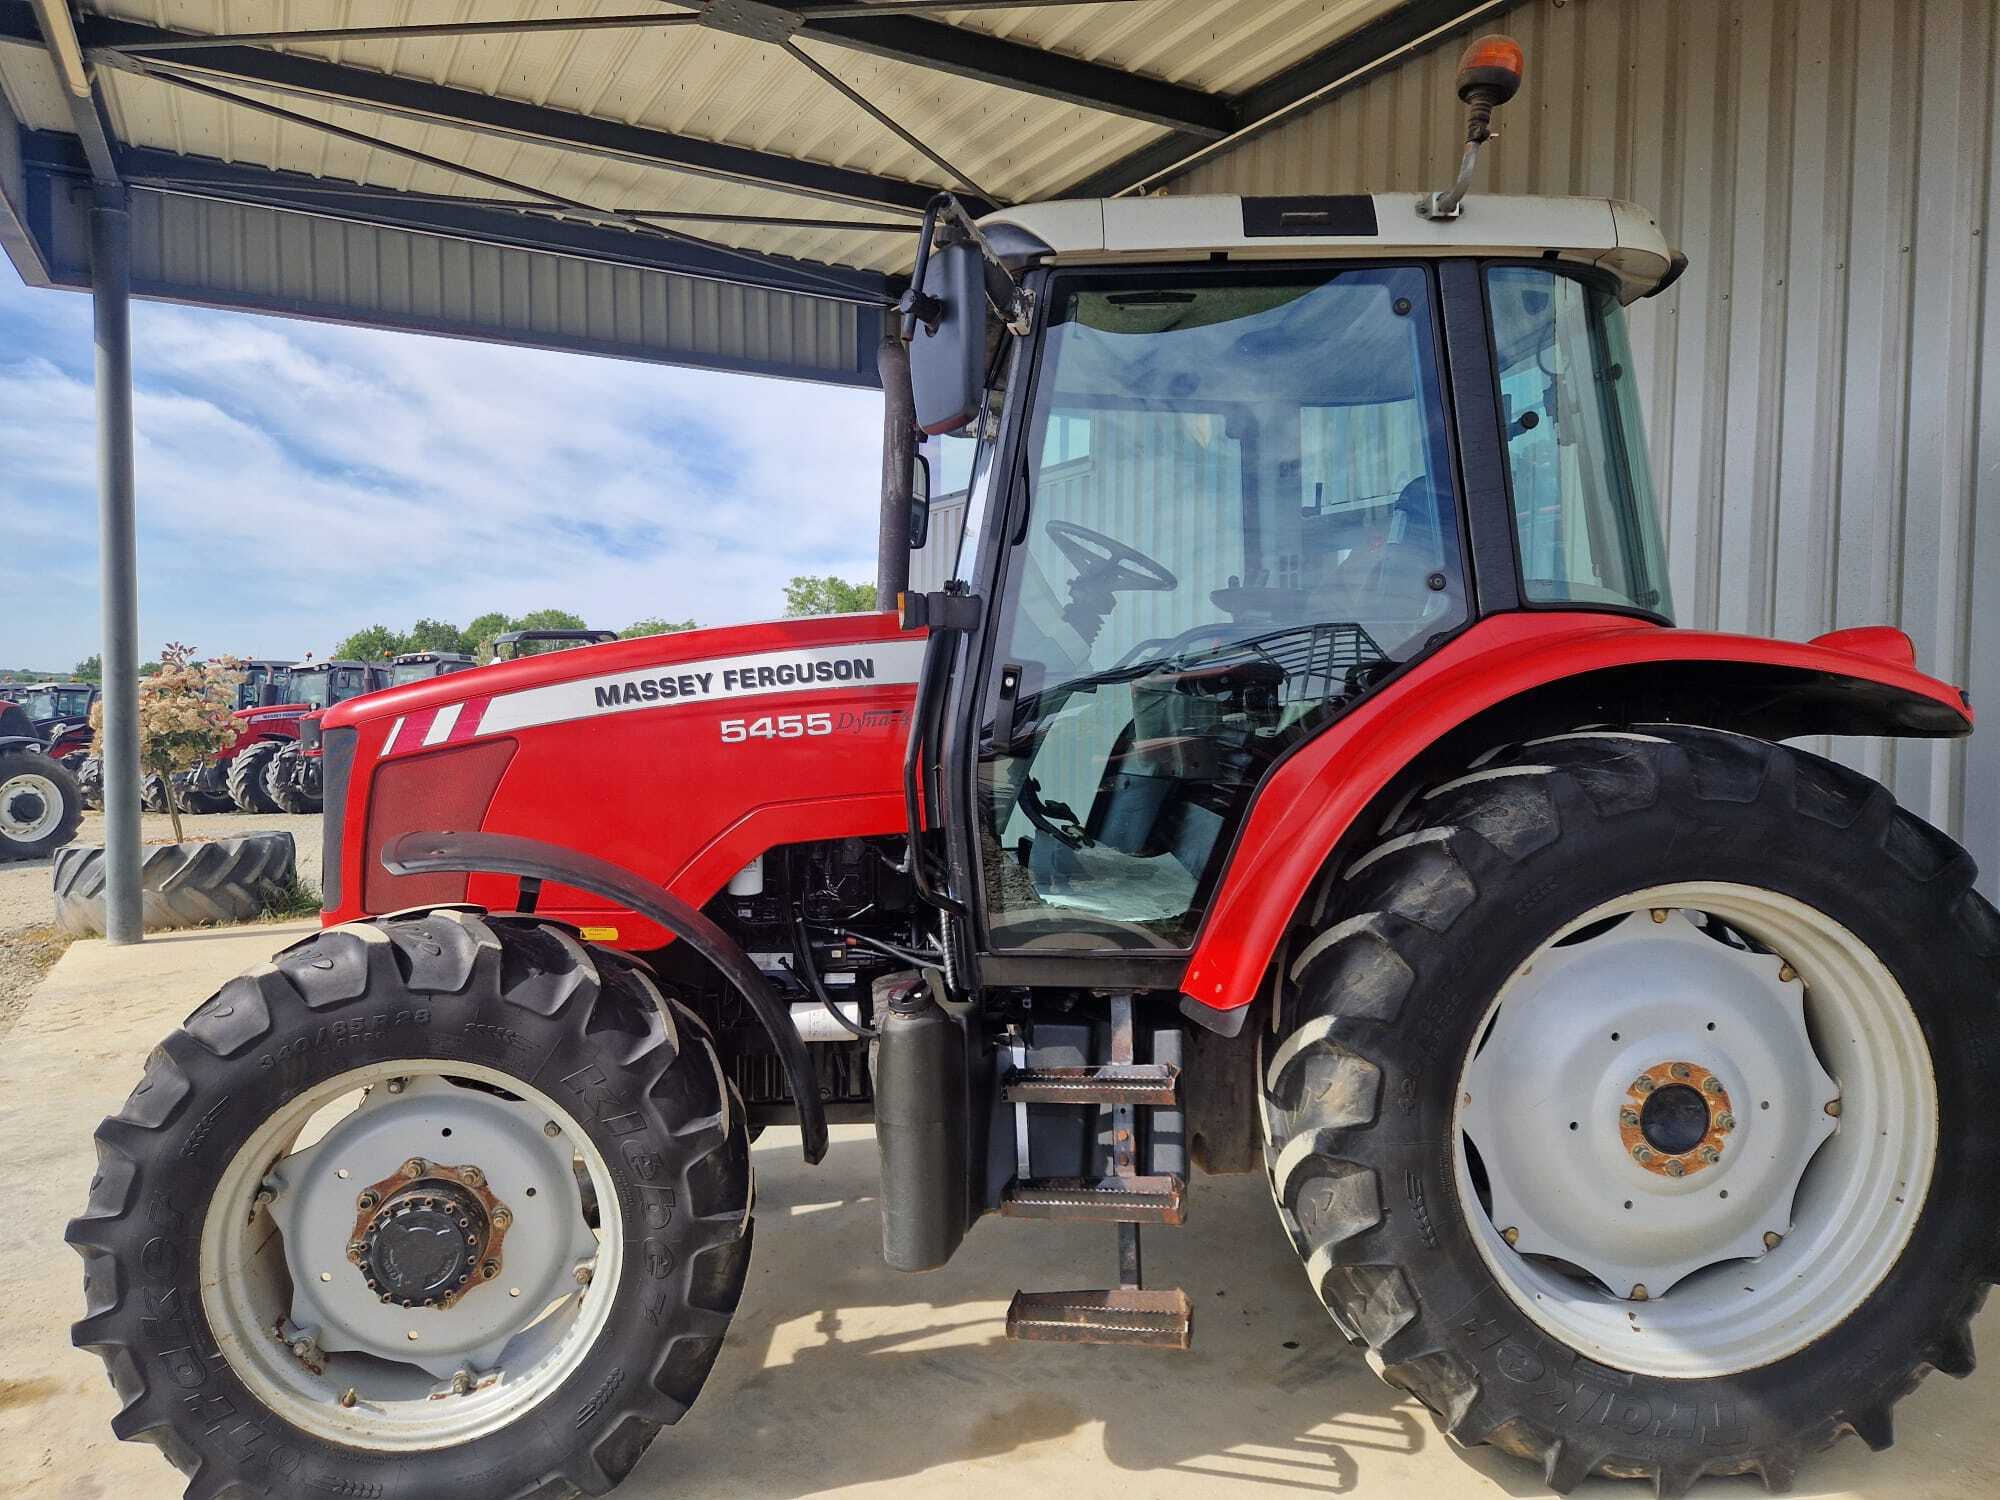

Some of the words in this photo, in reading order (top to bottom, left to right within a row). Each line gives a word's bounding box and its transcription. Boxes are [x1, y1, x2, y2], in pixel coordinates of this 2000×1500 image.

[594, 672, 713, 708] MASSEY
[723, 658, 875, 691] FERGUSON
[720, 712, 832, 743] 5455
